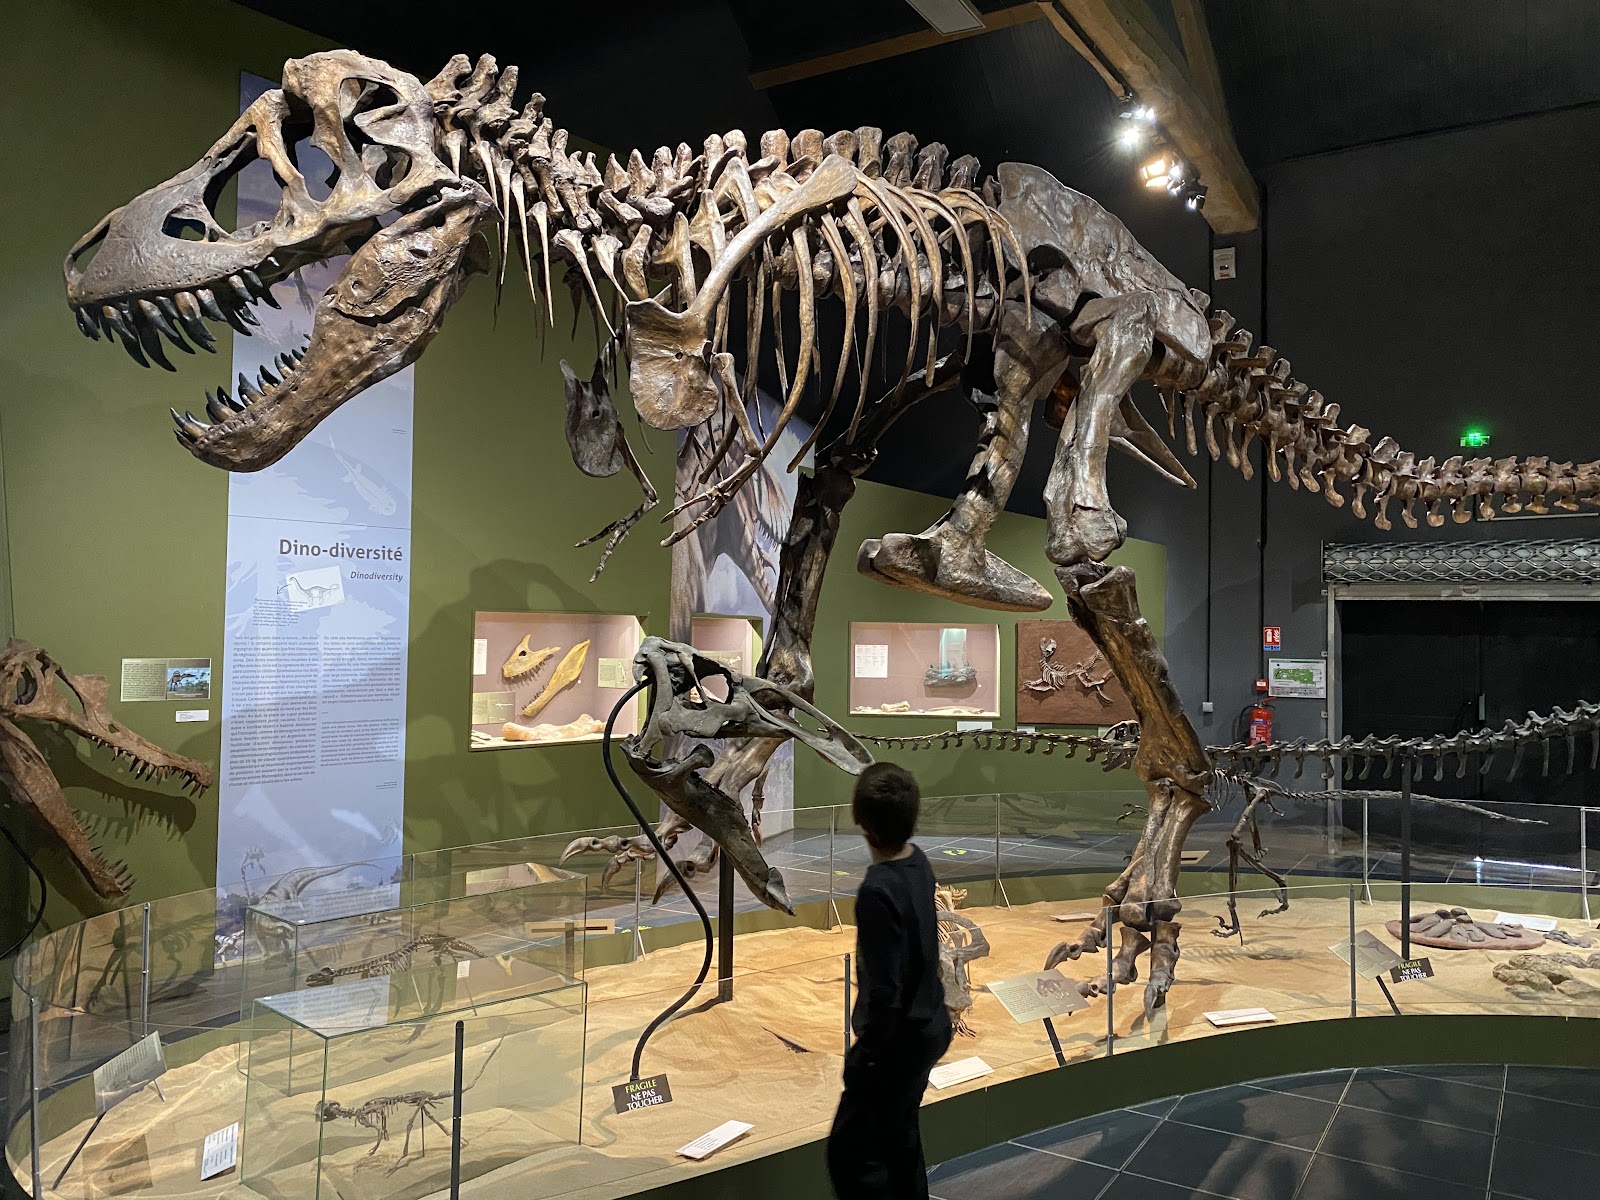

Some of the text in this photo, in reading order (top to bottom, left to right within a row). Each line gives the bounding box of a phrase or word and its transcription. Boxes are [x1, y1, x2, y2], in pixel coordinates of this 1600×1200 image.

[279, 538, 403, 561] Dino-diversité
[350, 571, 404, 583] Dinodiversity
[625, 1079, 656, 1094] FRAGILE
[626, 1095, 664, 1110] TOUCHER
[630, 1088, 656, 1102] NE PAS
